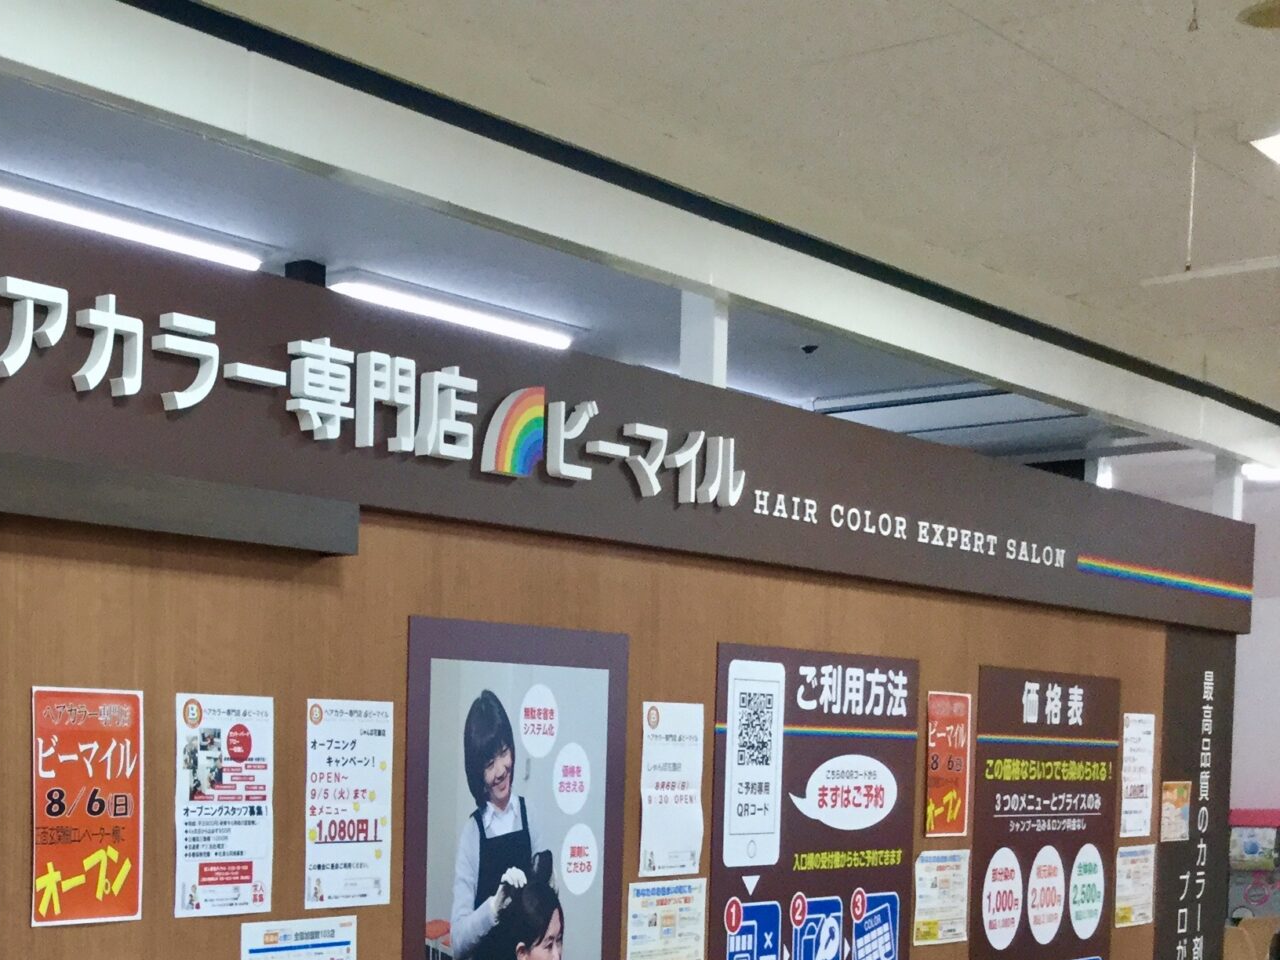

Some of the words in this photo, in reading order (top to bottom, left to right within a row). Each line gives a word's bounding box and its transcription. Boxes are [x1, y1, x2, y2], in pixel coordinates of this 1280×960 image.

[545, 401, 746, 508] ビーマイル
[753, 490, 818, 525] HAIR
[830, 504, 907, 540] COLOR
[918, 521, 997, 556] EXPERT
[1006, 539, 1066, 568] SALON
[796, 664, 908, 717] ご利用方法
[1022, 681, 1084, 726] 価格表
[523, 723, 555, 737] システム化
[311, 739, 357, 750] オープニング
[36, 734, 138, 780] ビーマイル
[558, 781, 585, 793] おさえる
[737, 782, 770, 795] ご予約専用
[817, 784, 884, 808] まずはご予約
[309, 805, 348, 816] 全メニュー
[736, 803, 769, 817] QRコード
[566, 860, 592, 873] こだわる
[36, 845, 132, 918] オープン
[855, 894, 862, 915] 3
[987, 890, 1019, 914] 1,000円
[1031, 886, 1061, 909] 2,000円
[1073, 883, 1101, 905] 2,500円
[729, 904, 738, 927] 1
[794, 900, 803, 920] 2
[864, 915, 882, 931] COLOR
